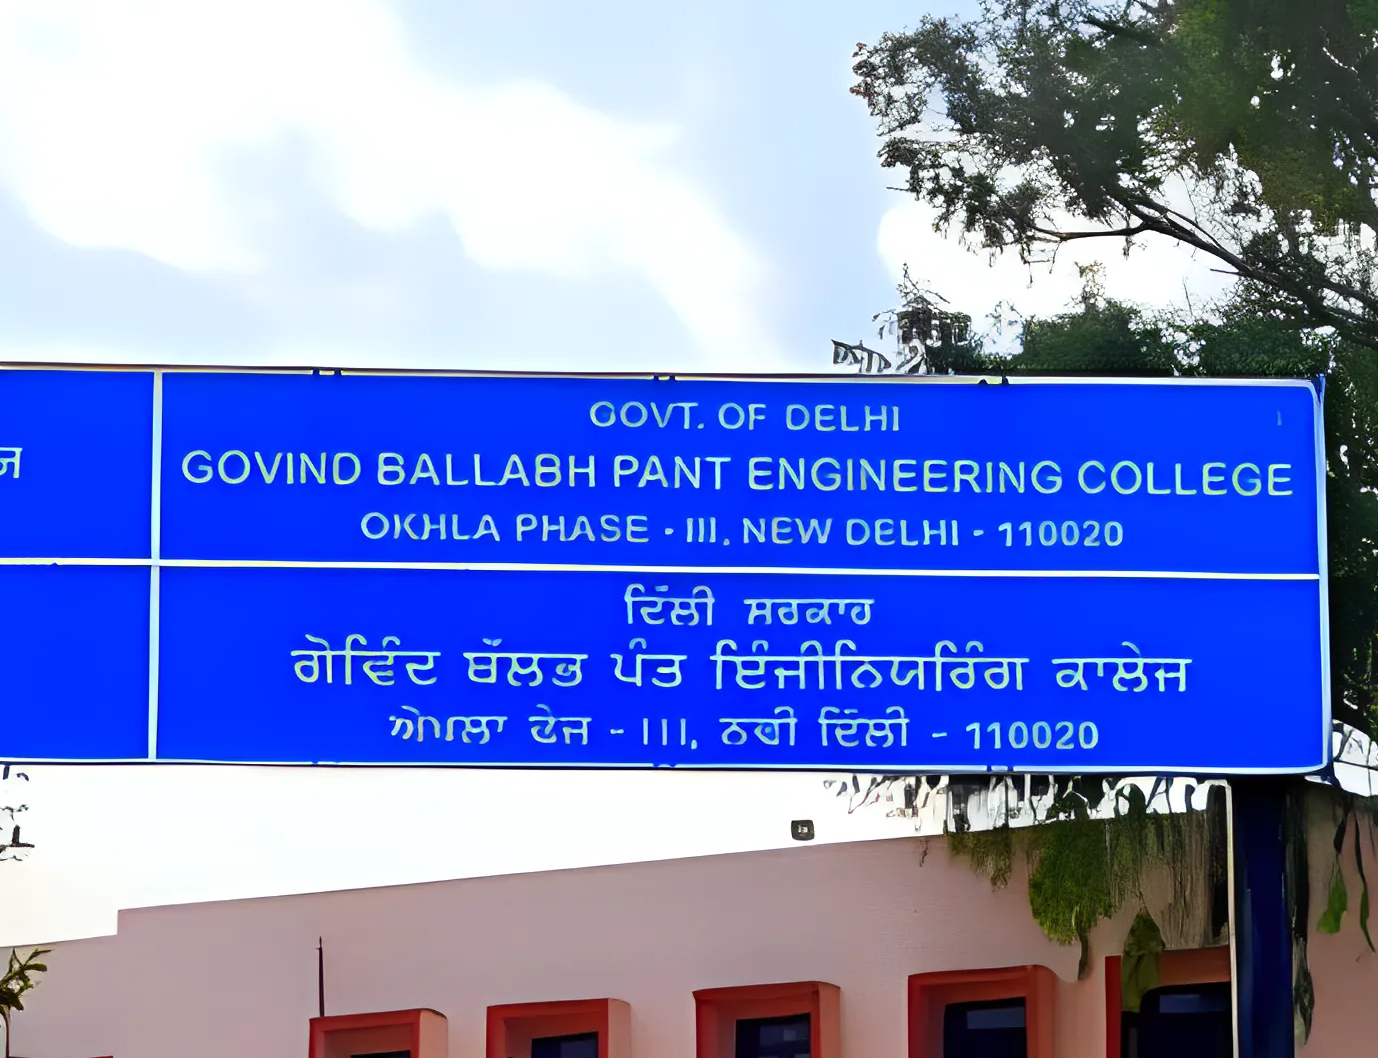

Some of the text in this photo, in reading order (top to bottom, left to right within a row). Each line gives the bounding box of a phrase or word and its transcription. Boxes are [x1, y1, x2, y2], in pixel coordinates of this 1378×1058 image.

[589, 400, 900, 432] GOVT. OF DELHI
[181, 449, 1294, 497] GOVIND BALLABH PANT ENGINEERING COLLEGE
[360, 511, 501, 542] OKHLA
[515, 513, 650, 543] PHASE
[742, 516, 833, 545] NEW
[845, 518, 959, 547] DELHI
[997, 519, 1124, 547] 110020
[965, 720, 1099, 750] 110020
